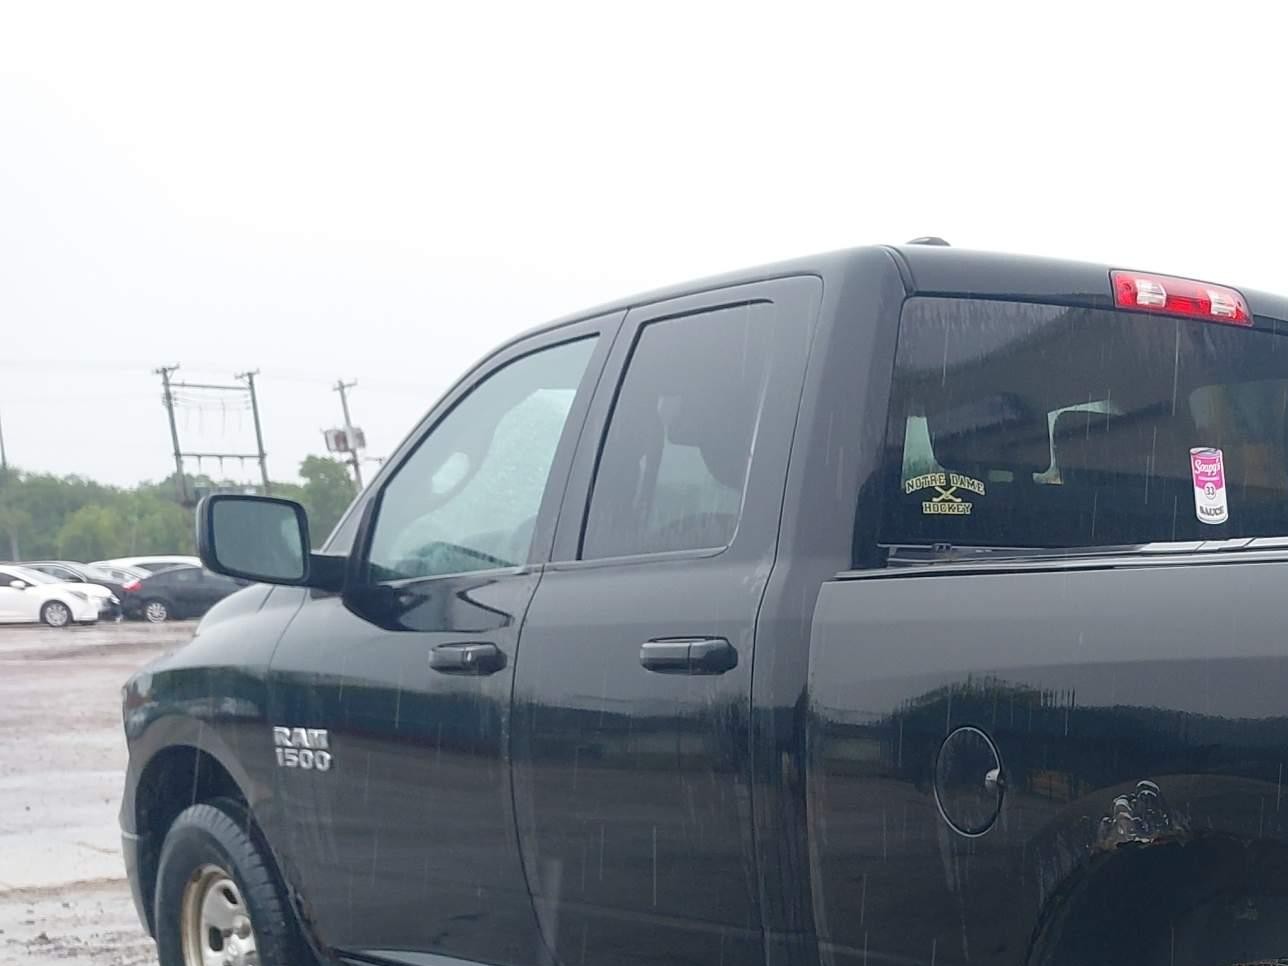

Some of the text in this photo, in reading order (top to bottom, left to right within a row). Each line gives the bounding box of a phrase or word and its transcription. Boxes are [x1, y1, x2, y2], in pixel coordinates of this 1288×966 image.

[905, 473, 986, 496] NOTRE DAME
[922, 501, 973, 515] HOCKEY
[273, 725, 328, 749] RAM
[275, 747, 331, 771] 1500
